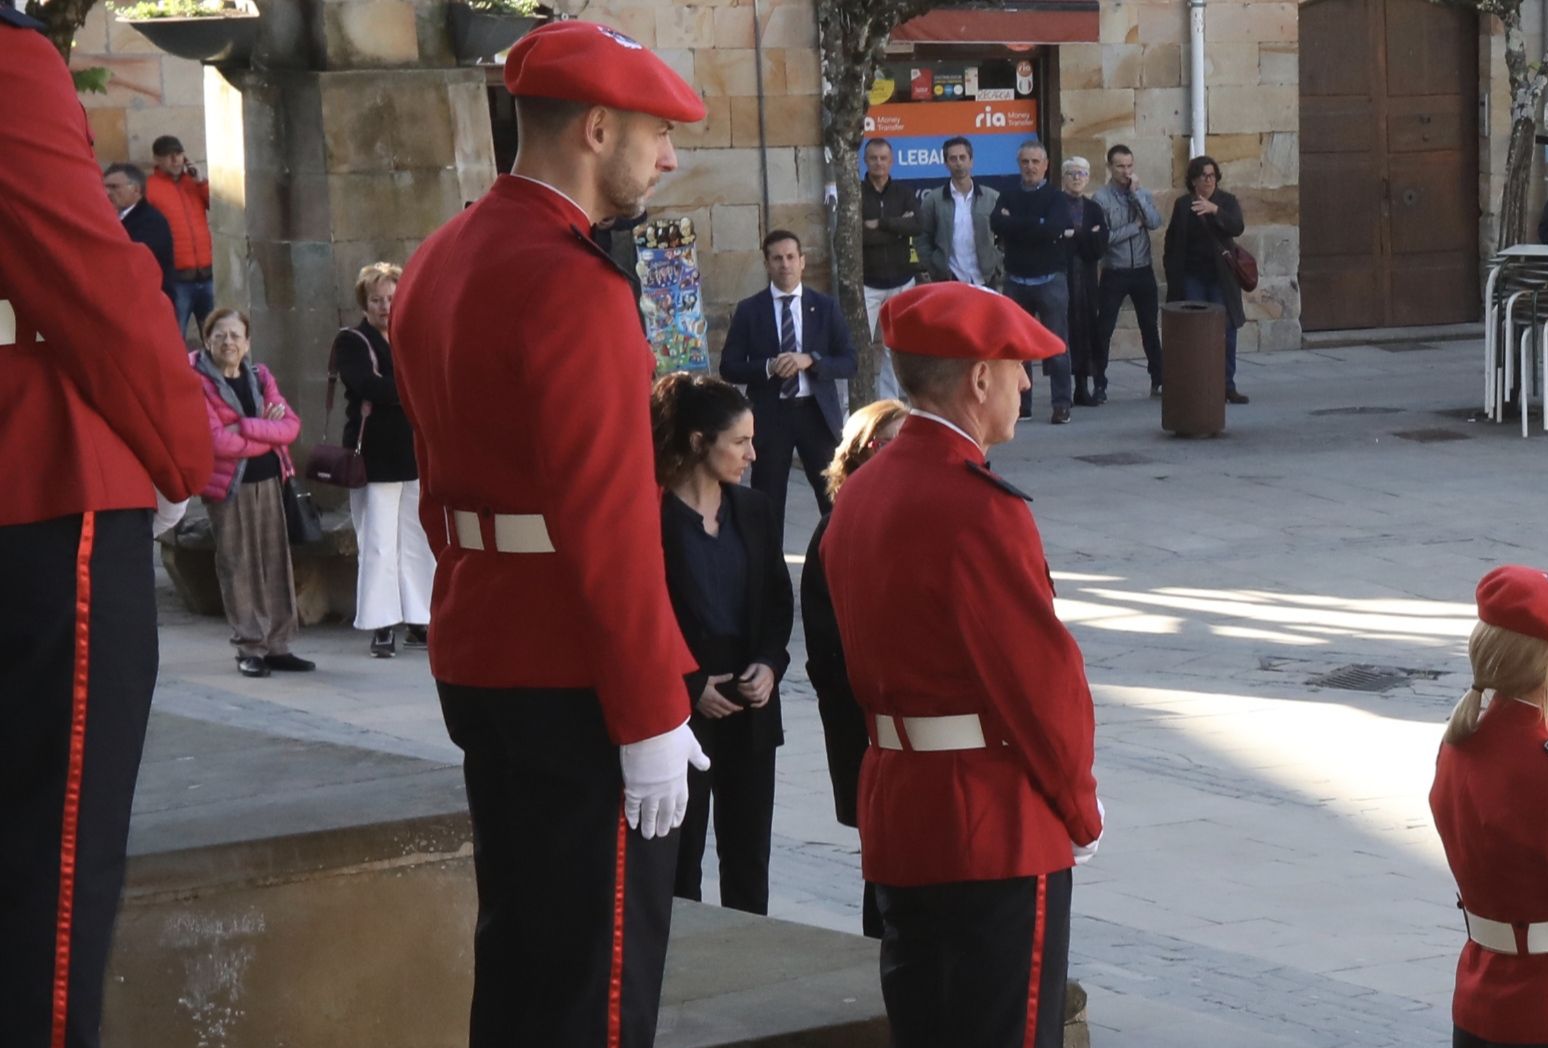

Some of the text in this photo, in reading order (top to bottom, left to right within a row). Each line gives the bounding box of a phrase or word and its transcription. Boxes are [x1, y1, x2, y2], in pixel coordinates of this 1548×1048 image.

[877, 116, 901, 125] Money
[975, 105, 1006, 128] ria
[1008, 112, 1030, 120] Money
[1008, 119, 1034, 127] Transfer
[898, 149, 944, 166] LEBA
